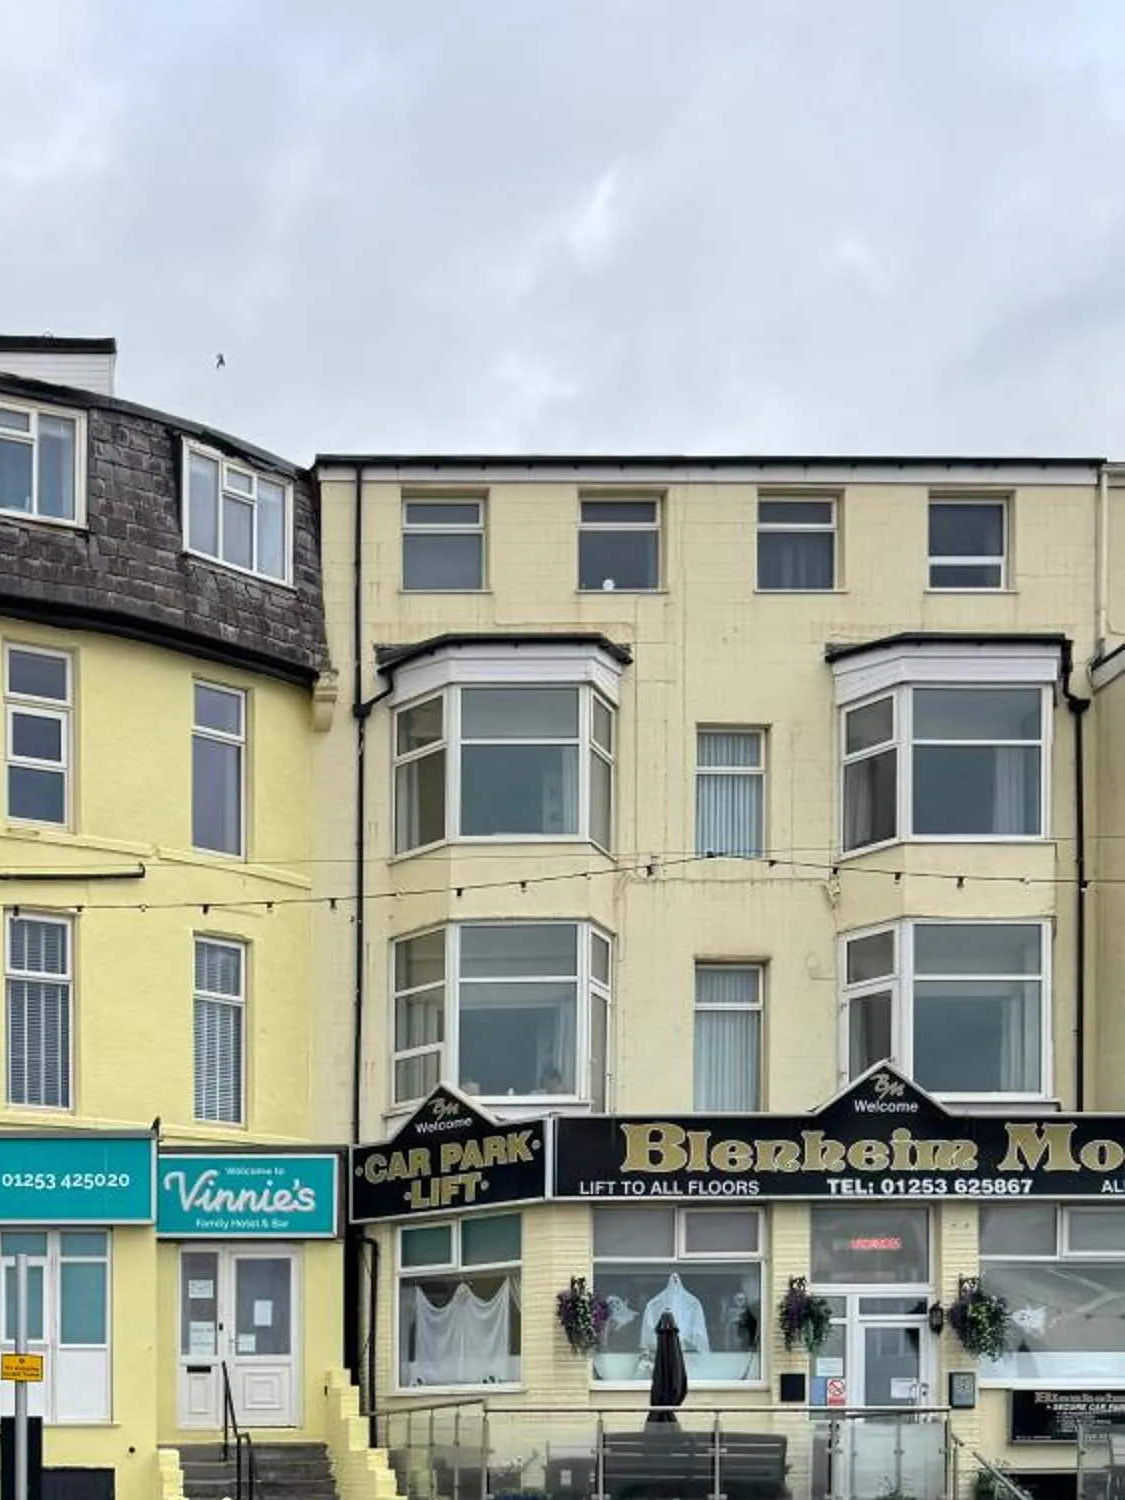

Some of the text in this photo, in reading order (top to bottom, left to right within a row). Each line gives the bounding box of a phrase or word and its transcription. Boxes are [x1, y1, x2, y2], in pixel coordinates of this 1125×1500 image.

[854, 1099, 920, 1113] Welcome
[415, 1117, 473, 1134] Welcome
[620, 1122, 978, 1174] Blenheim
[364, 1130, 535, 1184] CAR PARK
[226, 1167, 285, 1176] Welcome to
[2, 1173, 131, 1189] 01253 425020
[580, 1181, 760, 1195] LIFT TO ALL FLOORS
[827, 1179, 1034, 1194] TEL: 01253 625867
[162, 1169, 316, 1213] Vinnie's
[411, 1171, 483, 1209] LIFT
[196, 1218, 228, 1230] Family
[231, 1218, 260, 1229] Hotel
[272, 1219, 289, 1229] Bar
